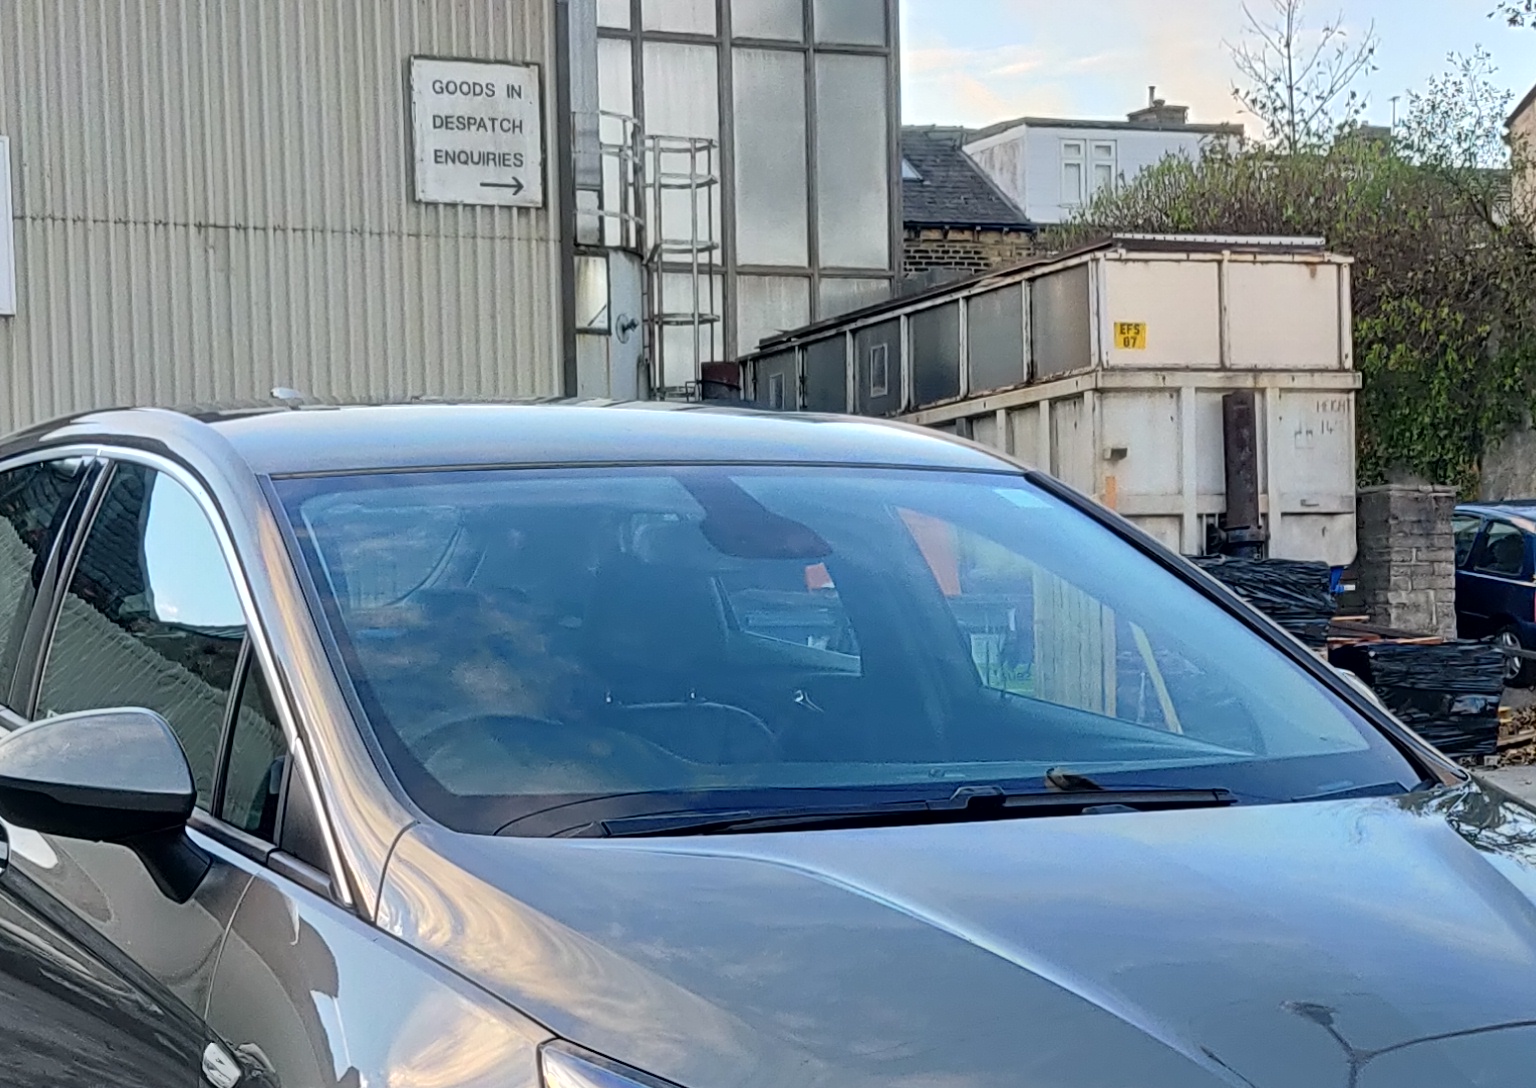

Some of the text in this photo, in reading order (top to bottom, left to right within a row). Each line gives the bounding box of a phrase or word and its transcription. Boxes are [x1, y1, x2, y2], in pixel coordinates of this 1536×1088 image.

[432, 79, 522, 100] GOODS IN
[432, 114, 523, 135] DESPATCH
[433, 149, 524, 168] ENQUIRIES
